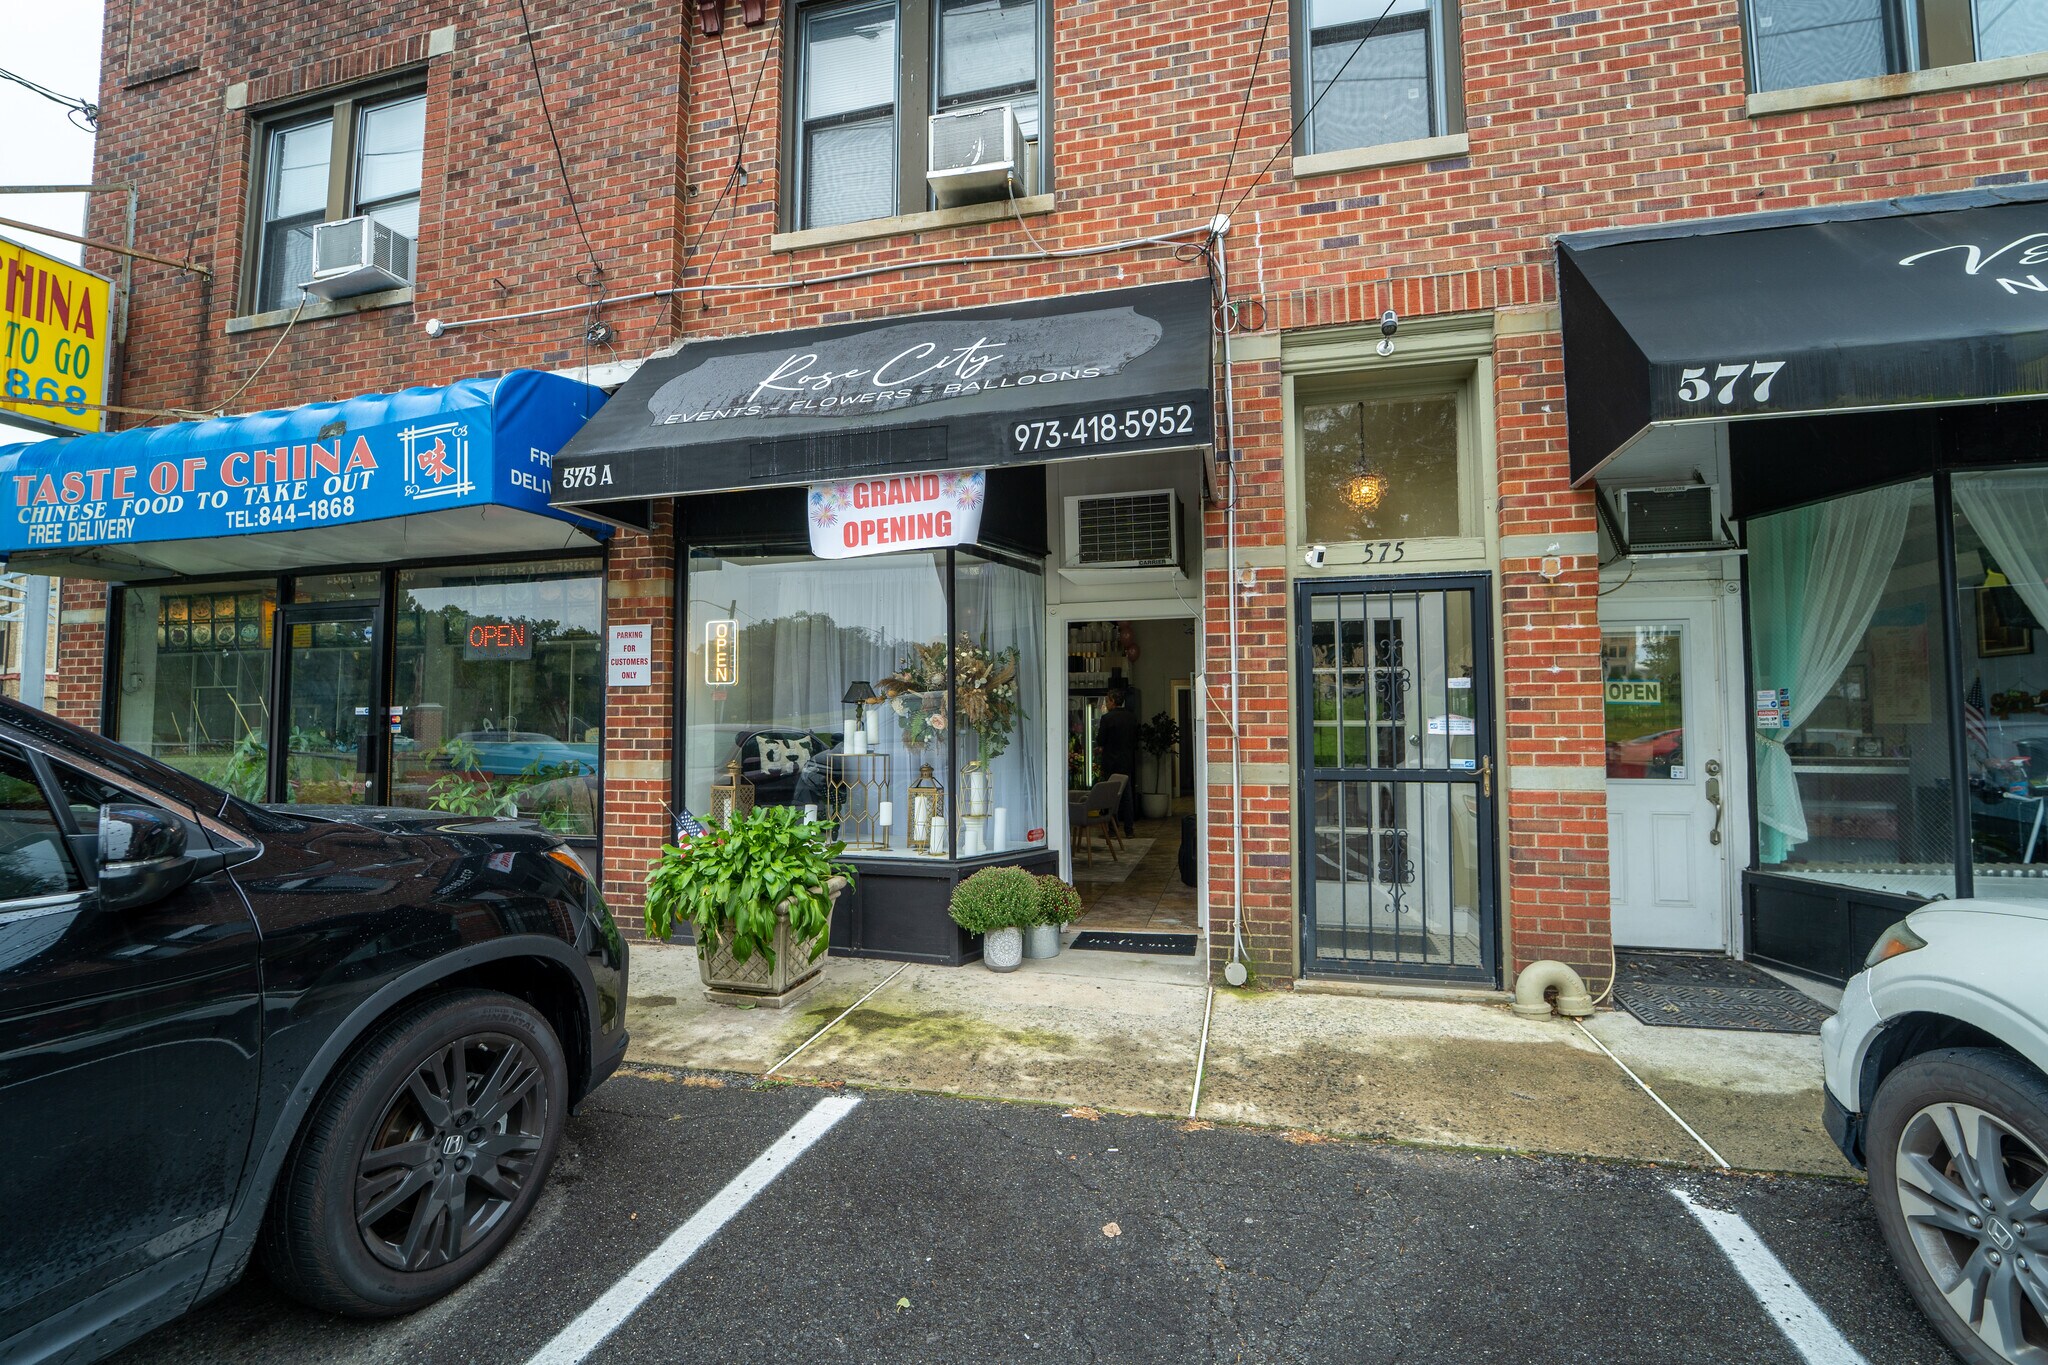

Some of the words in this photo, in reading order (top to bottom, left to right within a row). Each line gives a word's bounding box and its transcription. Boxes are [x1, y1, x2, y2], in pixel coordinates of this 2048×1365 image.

[0, 255, 95, 339] HINA
[5, 321, 39, 364] TO
[55, 338, 90, 379] GO
[747, 353, 871, 403] Rose
[872, 337, 1007, 387] City
[1678, 360, 1786, 405] 577
[4, 368, 87, 416] 868
[663, 405, 762, 425] EVENTS
[788, 388, 913, 411] FLOWERS
[943, 367, 1100, 393] BALLOONS
[1014, 404, 1193, 451] 973-418-5952
[13, 465, 137, 506] TASTE
[149, 457, 207, 495] OF
[220, 435, 379, 487] CHINA
[417, 436, 456, 484] 味
[531, 447, 553, 468] FR
[562, 464, 597, 489] 575
[600, 464, 613, 486] A
[853, 474, 940, 510] GRAND
[18, 501, 108, 525] CHINESE
[120, 495, 184, 517] FOOD
[197, 490, 228, 510] TO
[243, 480, 308, 506] TAKE
[323, 470, 375, 496] OUT
[225, 495, 355, 529] TEL:844-1868
[27, 522, 63, 545] FREE
[67, 517, 136, 542] DELIVERY
[843, 510, 952, 548] OPENING
[1362, 542, 1405, 564] 575
[469, 624, 525, 648] OPEN
[616, 631, 643, 639] PARKING
[623, 644, 636, 652] FOR
[715, 623, 728, 682] OPEN
[610, 658, 649, 666] CUSTOMERS
[621, 671, 637, 679] ONLY
[1608, 684, 1658, 701] OPEN
